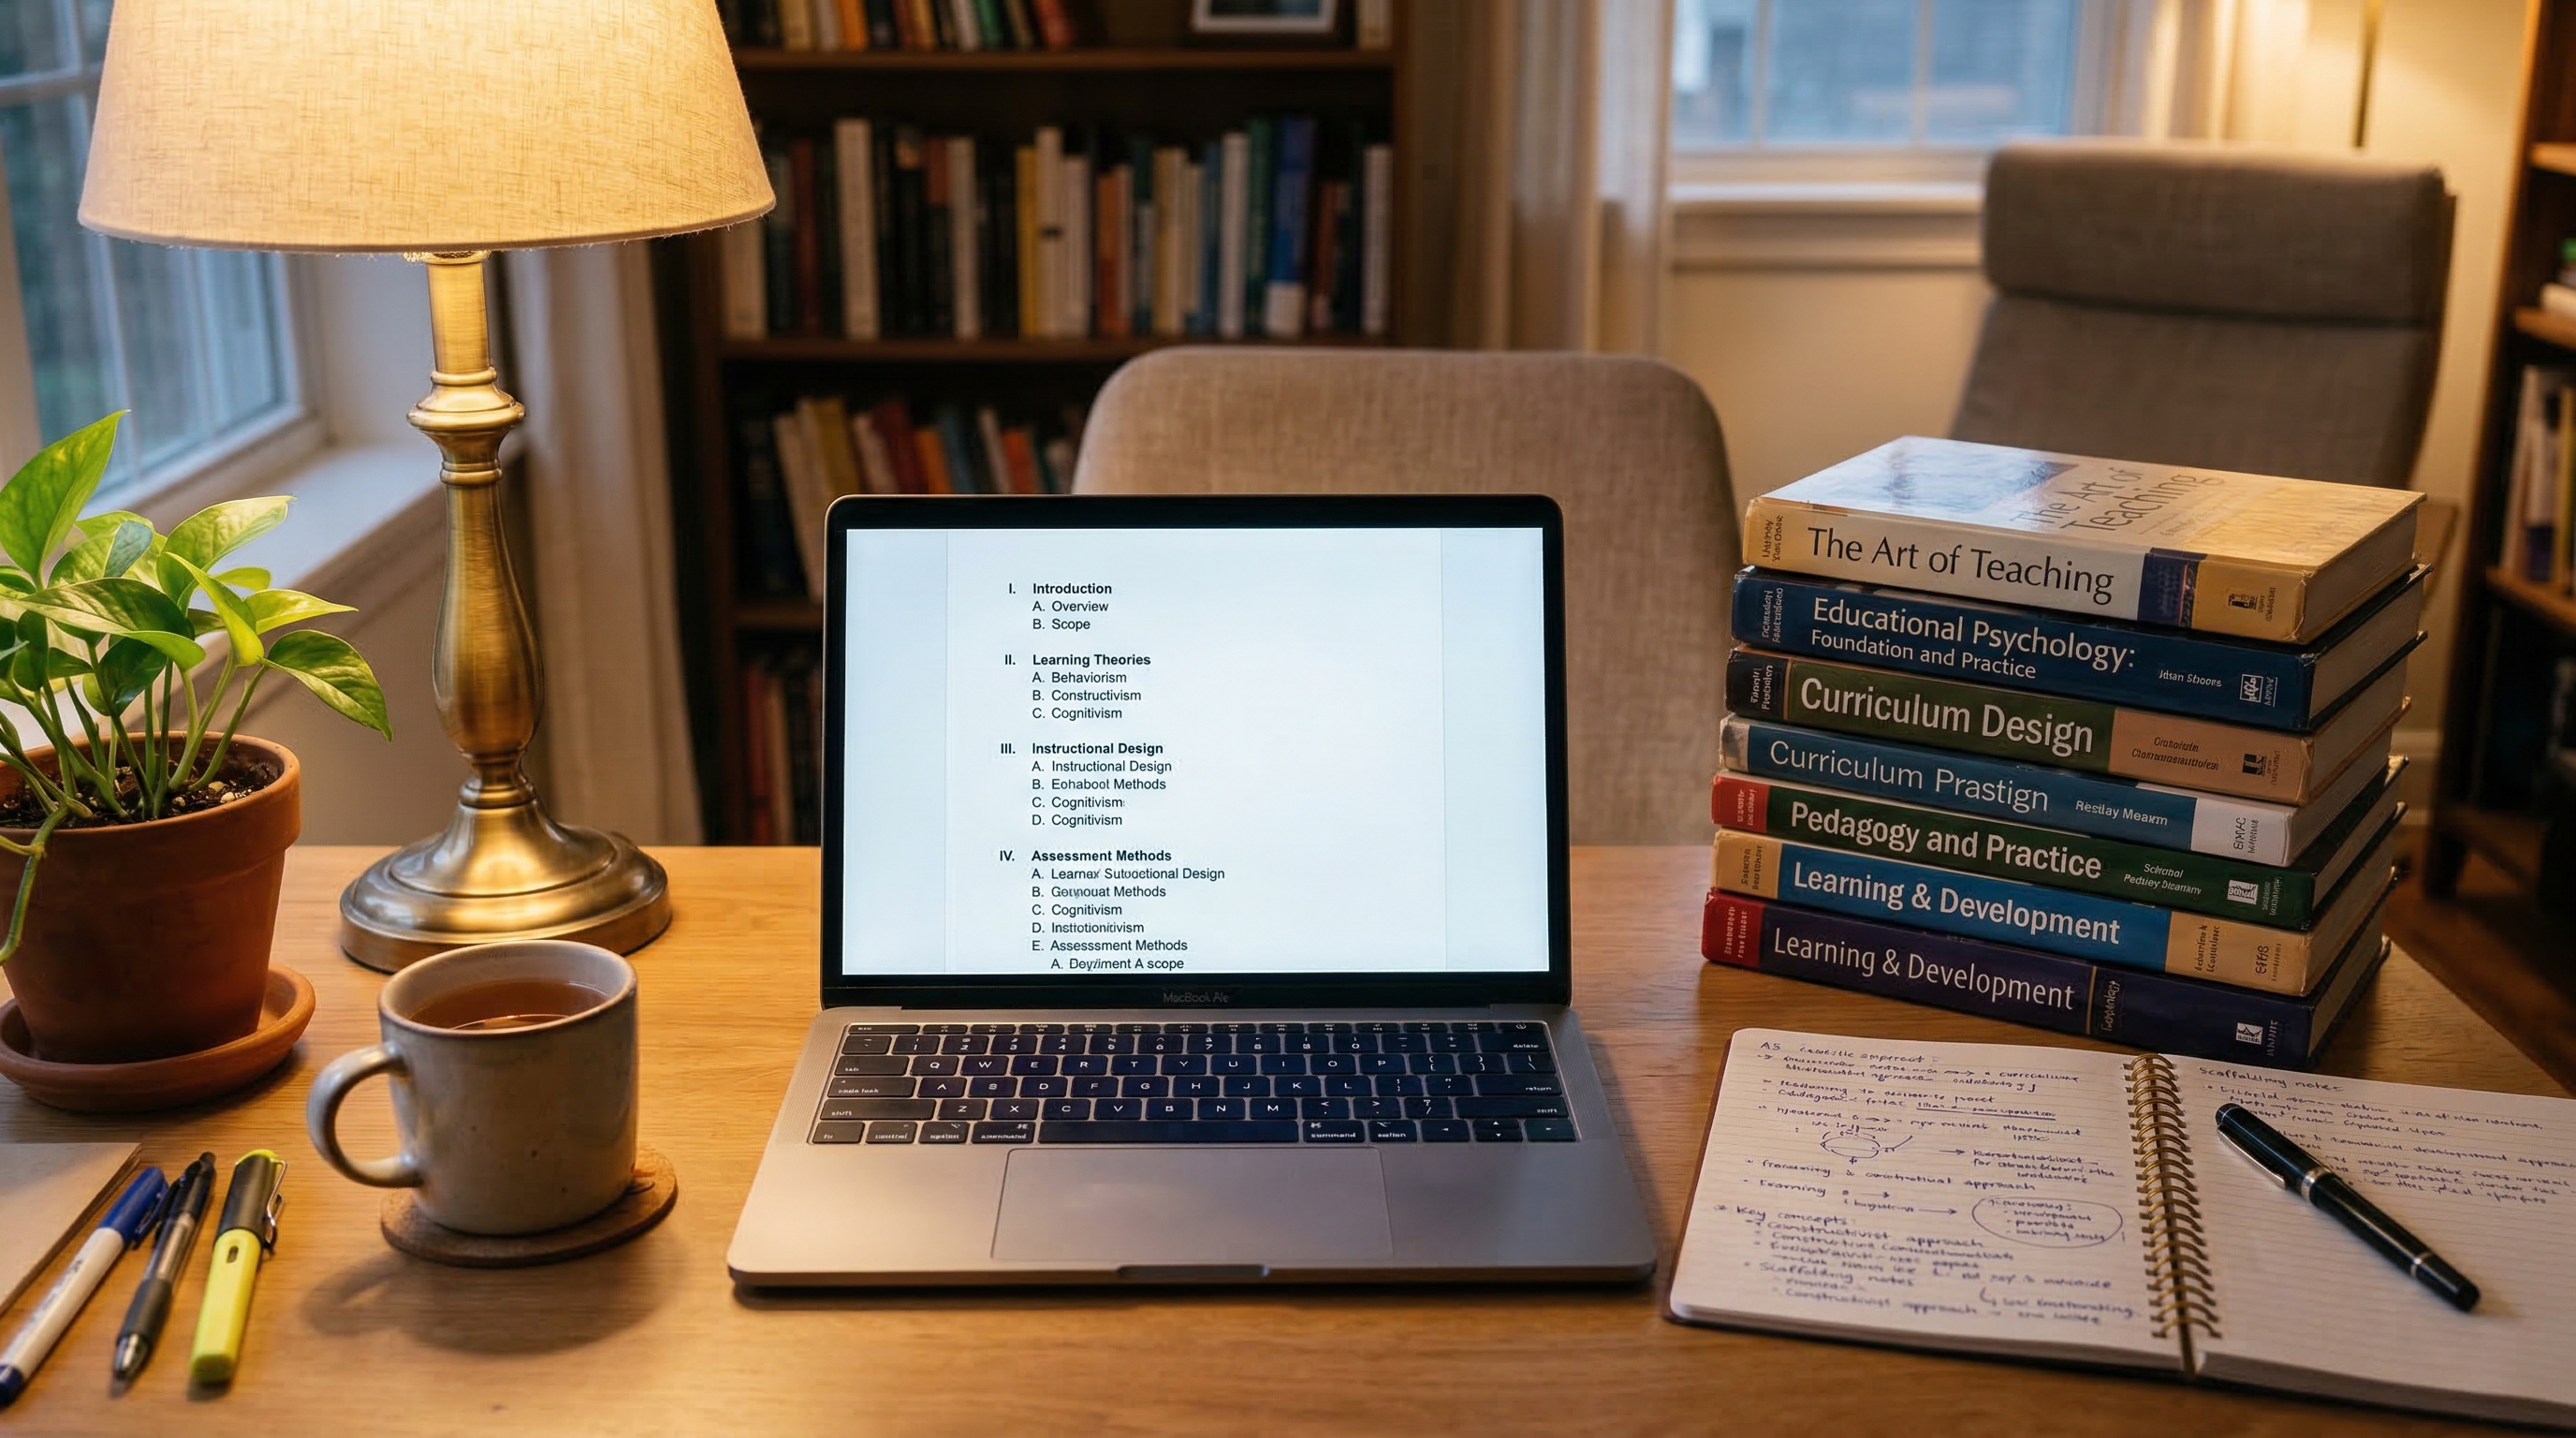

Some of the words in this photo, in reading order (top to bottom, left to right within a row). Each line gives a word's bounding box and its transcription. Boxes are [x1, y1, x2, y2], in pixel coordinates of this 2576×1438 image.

[1808, 527, 1863, 562] The
[1871, 536, 1919, 569] Art
[1928, 544, 1963, 575] of
[1970, 549, 2115, 606] Teaching
[1009, 583, 1016, 594] I.
[1033, 583, 1112, 594] Introduction
[1032, 601, 1045, 611] A.
[1052, 601, 1108, 611] Overview
[1033, 619, 1045, 629] B.
[1052, 619, 1090, 632] Scope
[1813, 597, 1964, 642] Educational
[1972, 620, 2135, 672] Psychology:
[1811, 629, 1914, 660] Foundation
[1921, 648, 1955, 667] and
[1962, 653, 2037, 679] Practice
[1005, 654, 1016, 665] II.
[1033, 654, 1090, 668] Learning
[1093, 654, 1150, 665] Theories
[1032, 671, 1045, 682] A.
[1052, 672, 1126, 682] Behaviorism
[1032, 690, 1044, 700] B.
[1052, 689, 1141, 701] Constructivism
[1032, 708, 1045, 718] C.
[1052, 708, 1121, 721] Cognitivism
[1801, 677, 1970, 733] Curriculum
[1982, 704, 2093, 757] Design
[1001, 743, 1016, 754] III.
[1032, 742, 1113, 754] Instructional
[1119, 742, 1163, 756] Design
[1032, 761, 1044, 771] A.
[1052, 760, 1125, 771] Instructional
[1130, 760, 1171, 774] Design
[1032, 779, 1044, 789] B.
[1114, 779, 1166, 789] Methods
[1770, 741, 1924, 789] Curriculum
[1936, 768, 2048, 814] Prastign
[1032, 797, 1045, 808] C.
[1032, 814, 1045, 825] D.
[1052, 814, 1122, 828] Cognitivism
[1791, 801, 1920, 853] Pedagogy
[1926, 831, 1979, 858] and
[1986, 830, 2101, 879] Practice
[1000, 850, 1015, 861] IV.
[1032, 850, 1112, 861] Assessment
[1117, 850, 1172, 861] Methods
[1032, 868, 1044, 879] A.
[1183, 868, 1224, 882] Design
[1032, 887, 1044, 897] B.
[1114, 886, 1166, 897] Methods
[1794, 861, 1905, 910] Learning
[1911, 884, 1931, 910] &
[1940, 888, 2120, 945] Development
[1032, 904, 1045, 915] C.
[1052, 904, 1121, 917] Cognitivism
[1032, 922, 1045, 932] D.
[1032, 940, 1044, 950] E.
[1135, 940, 1188, 950] Methods
[1051, 959, 1063, 969] A.
[1134, 958, 1144, 968] A
[1148, 961, 1184, 971] scope
[1775, 928, 1875, 977] Learning
[1882, 948, 1901, 976] &
[1909, 953, 2074, 1011] Development
